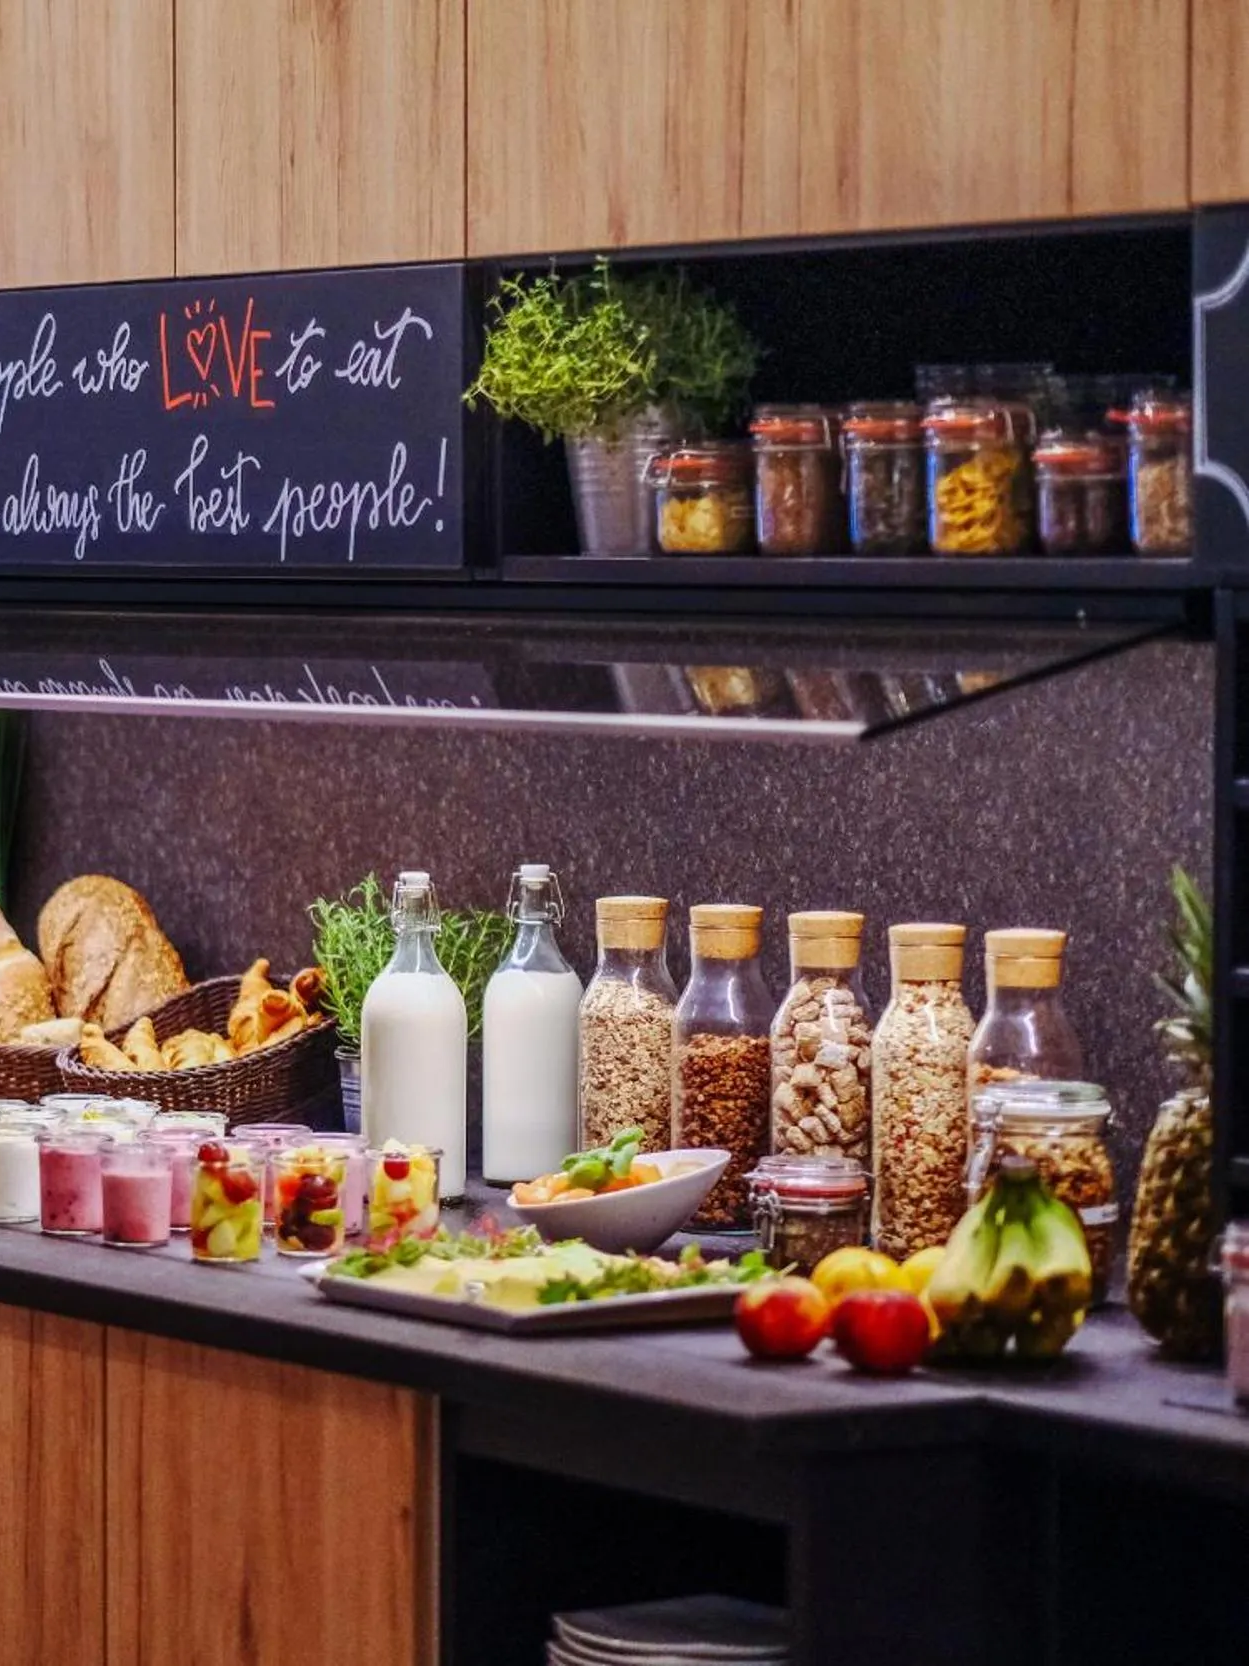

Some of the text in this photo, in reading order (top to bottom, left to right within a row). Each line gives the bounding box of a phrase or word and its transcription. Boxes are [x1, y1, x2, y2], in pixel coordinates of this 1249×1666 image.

[71, 321, 150, 394] who
[275, 317, 326, 394] to
[334, 307, 433, 389] eat
[2, 453, 101, 560] always
[107, 448, 166, 533] the
[175, 434, 261, 535] best
[263, 437, 448, 562] people!
